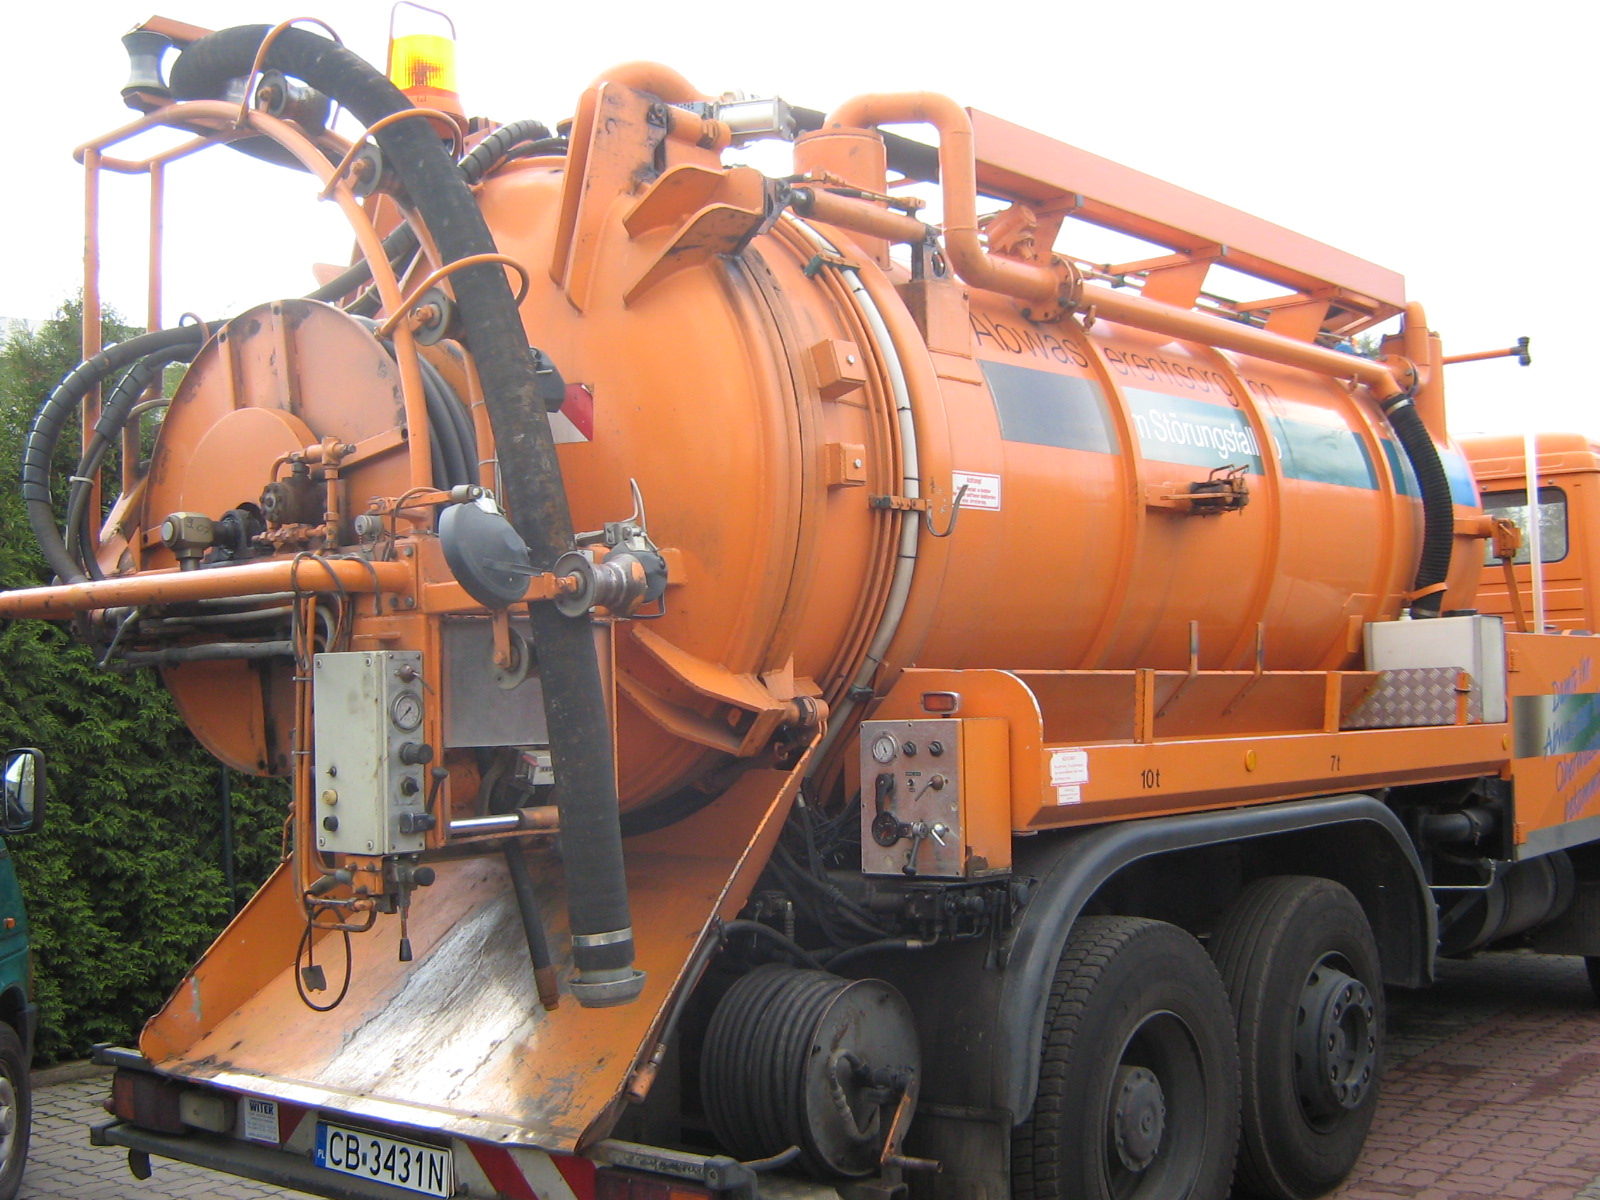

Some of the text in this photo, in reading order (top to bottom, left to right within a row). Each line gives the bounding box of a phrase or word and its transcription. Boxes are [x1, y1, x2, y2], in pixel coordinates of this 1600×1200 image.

[1150, 408, 1260, 460] Störungsfall
[317, 1149, 325, 1160] PL
[369, 1140, 444, 1192] 3431N
